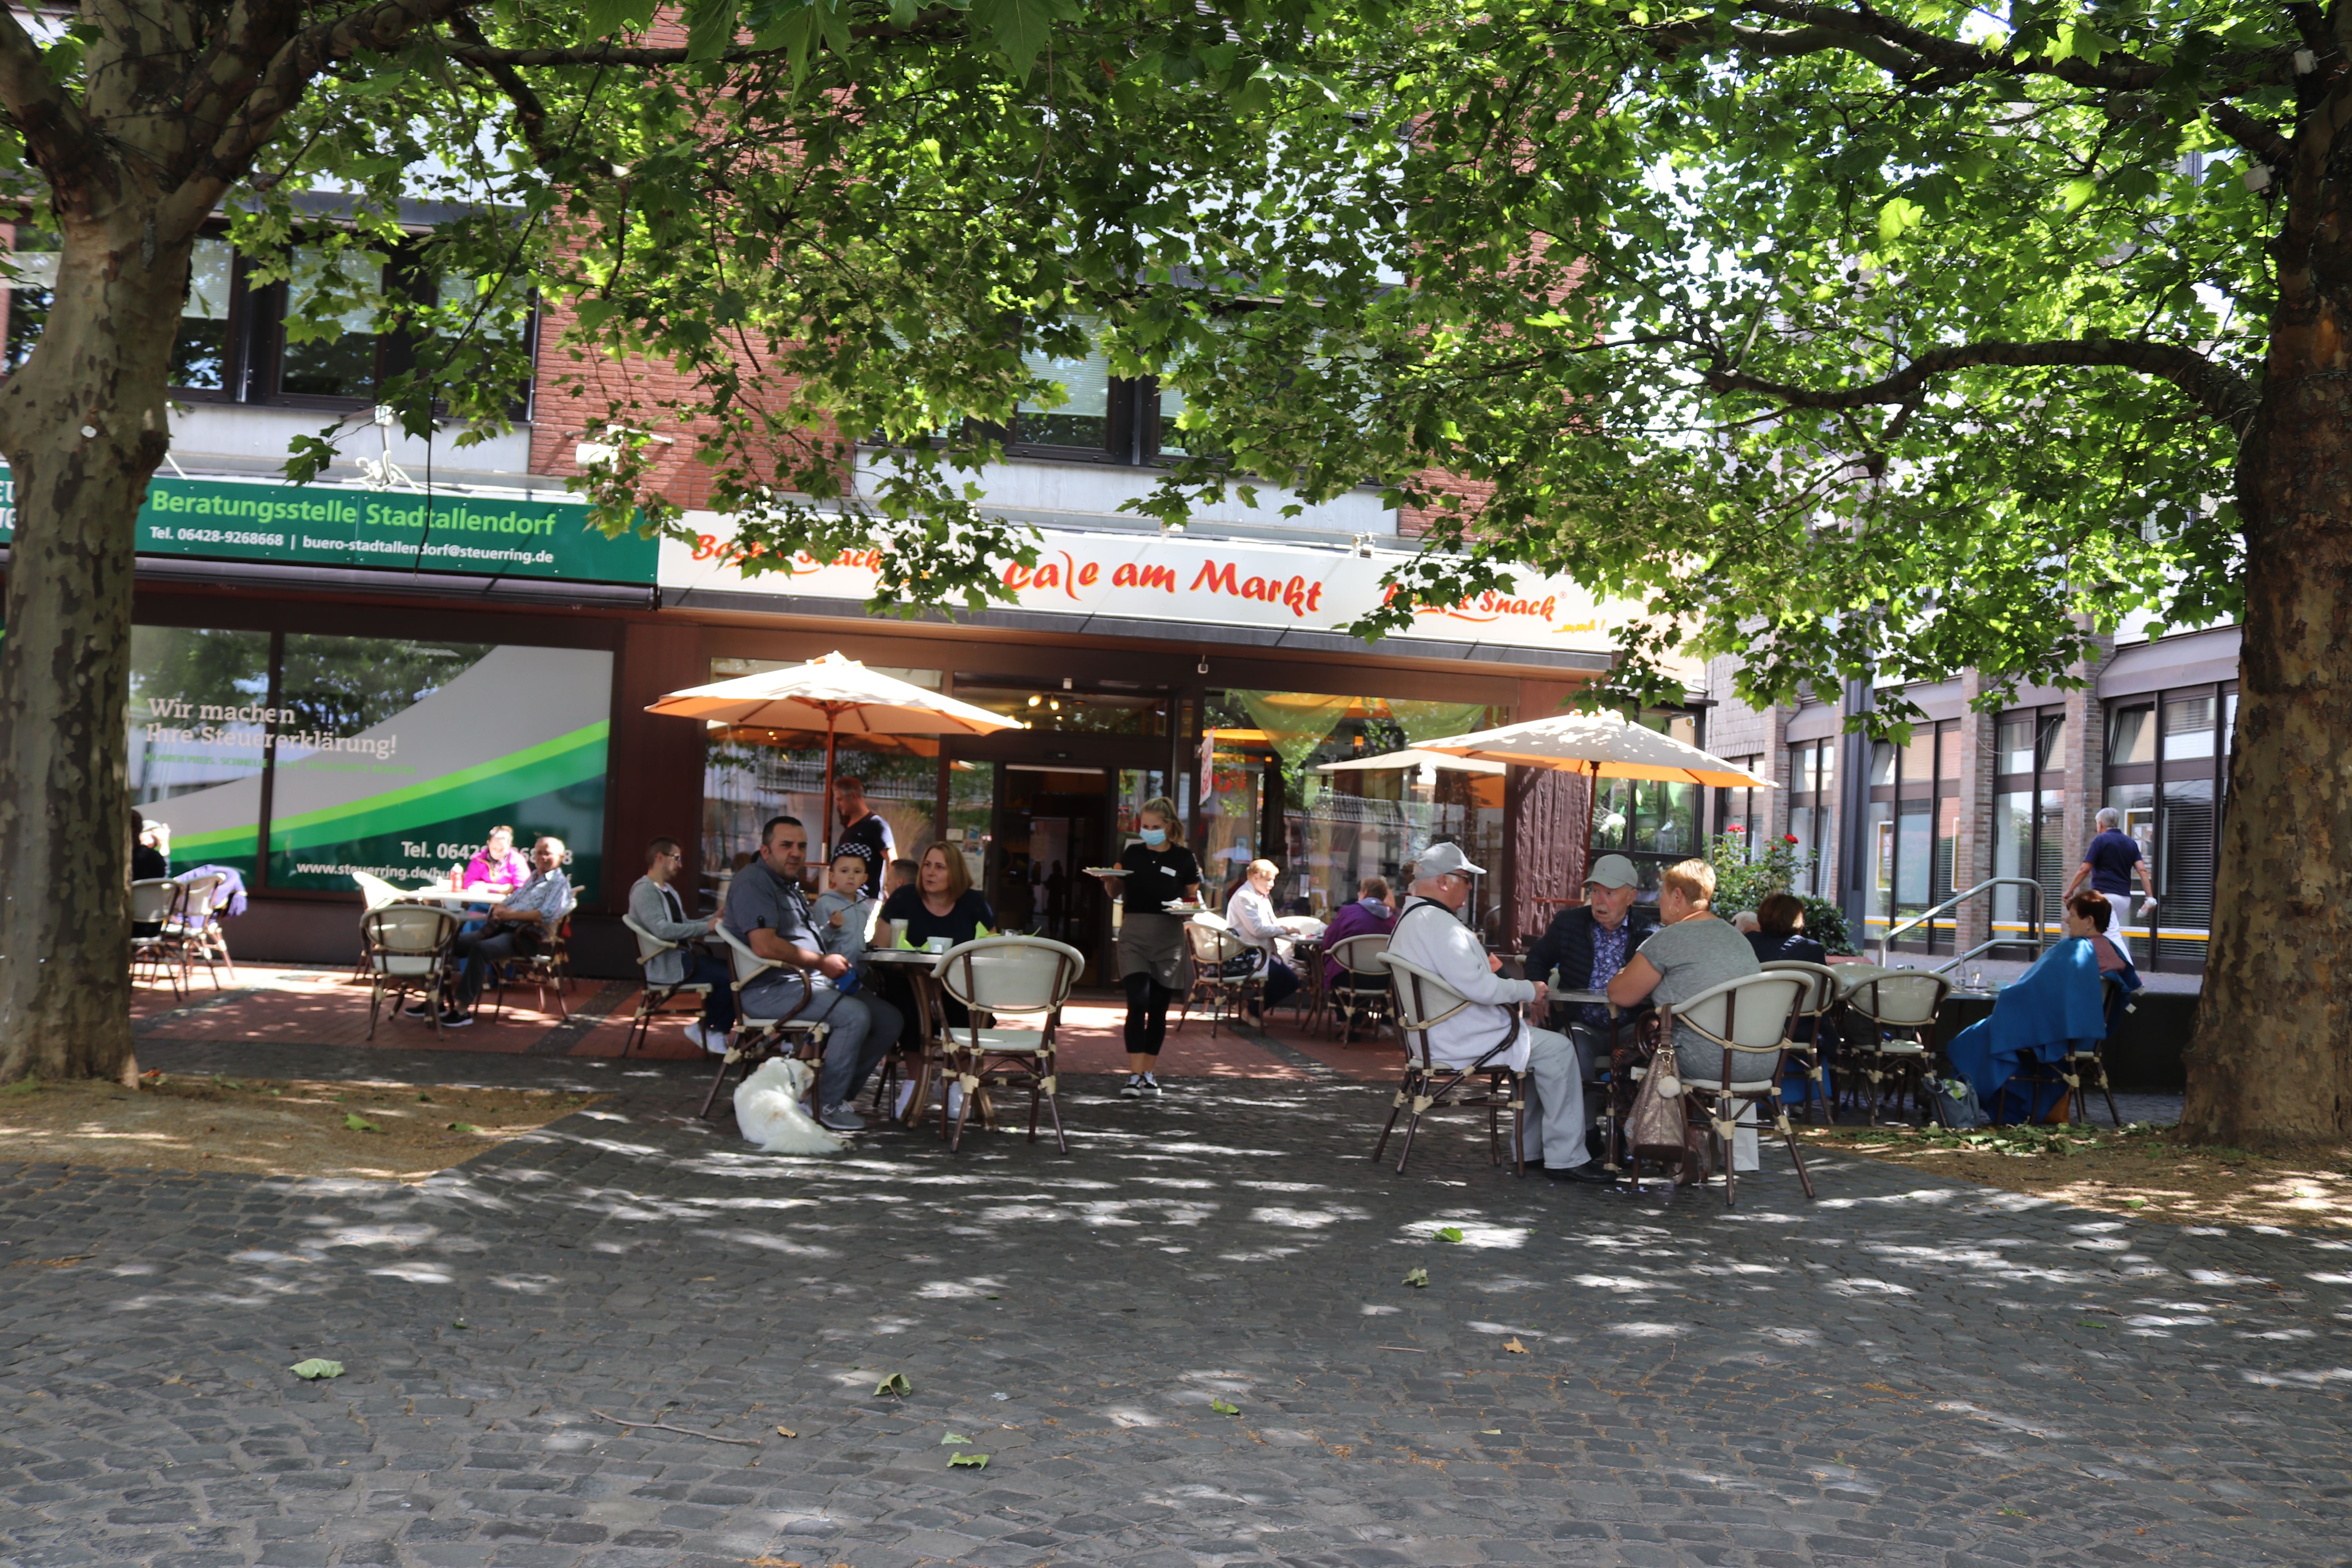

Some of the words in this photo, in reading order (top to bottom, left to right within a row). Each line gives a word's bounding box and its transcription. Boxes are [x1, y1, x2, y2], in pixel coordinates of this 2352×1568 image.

[152, 490, 359, 524] Beratungsstelle
[366, 503, 556, 535] Stadtallendorf
[149, 526, 174, 539] Tel.
[177, 528, 284, 546] 06428-9268668
[1112, 563, 1176, 594] am
[1190, 559, 1323, 618] Markt
[1479, 590, 1556, 622] Snack
[147, 697, 193, 719] Wir
[199, 701, 296, 725] machen
[146, 722, 194, 744] Ihre
[200, 726, 397, 760] Steuererklärung!
[401, 841, 432, 858] Tel.
